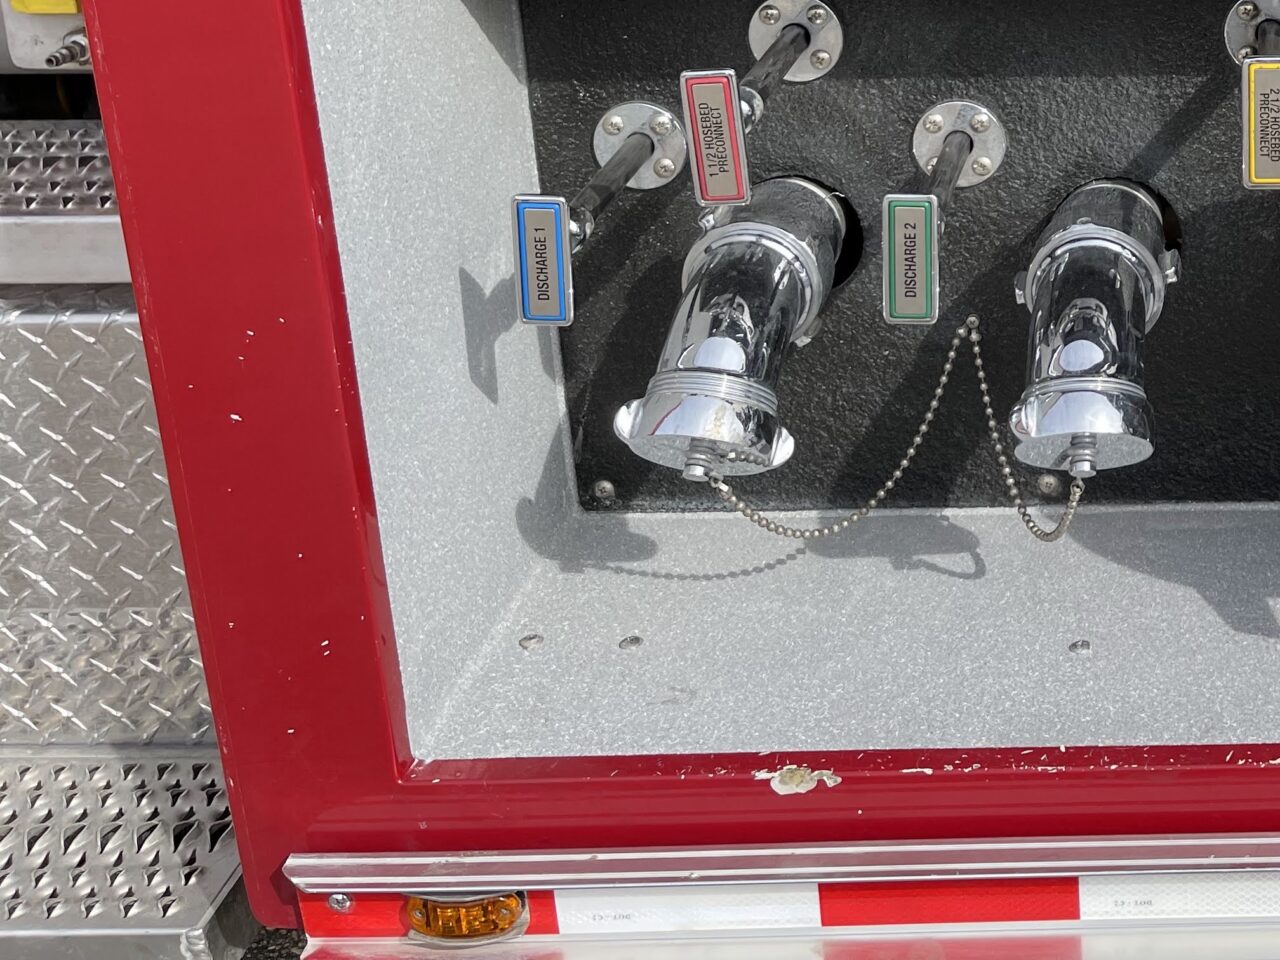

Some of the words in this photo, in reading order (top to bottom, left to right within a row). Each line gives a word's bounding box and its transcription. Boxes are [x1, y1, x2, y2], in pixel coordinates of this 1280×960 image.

[699, 102, 715, 150] HOSEBED
[1259, 93, 1270, 158] PRECONNECT
[1270, 99, 1280, 114] 1/2
[705, 152, 718, 169] 1/2
[710, 107, 729, 173] PRECONNECT
[1270, 116, 1280, 162] HOSEBED
[534, 237, 550, 302] DISCHARGE
[904, 233, 917, 298] DISCHARGE
